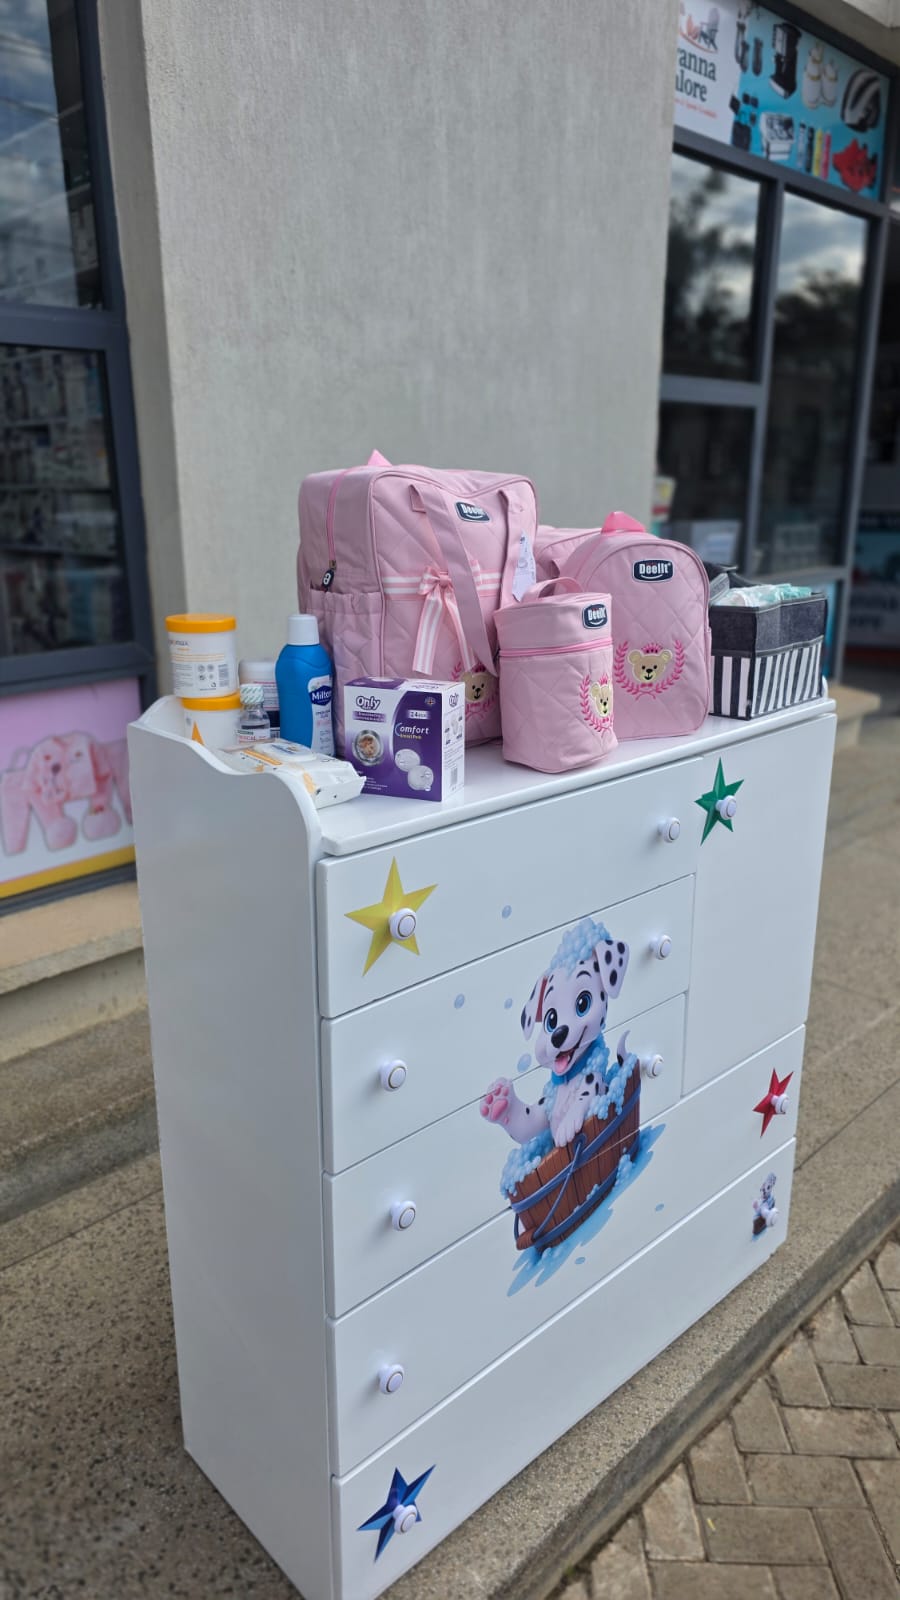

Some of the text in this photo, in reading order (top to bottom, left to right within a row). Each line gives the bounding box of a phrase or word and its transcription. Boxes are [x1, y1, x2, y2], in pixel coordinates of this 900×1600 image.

[677, 48, 716, 81] anna
[356, 695, 380, 711] Only
[395, 722, 430, 737] Comfort
